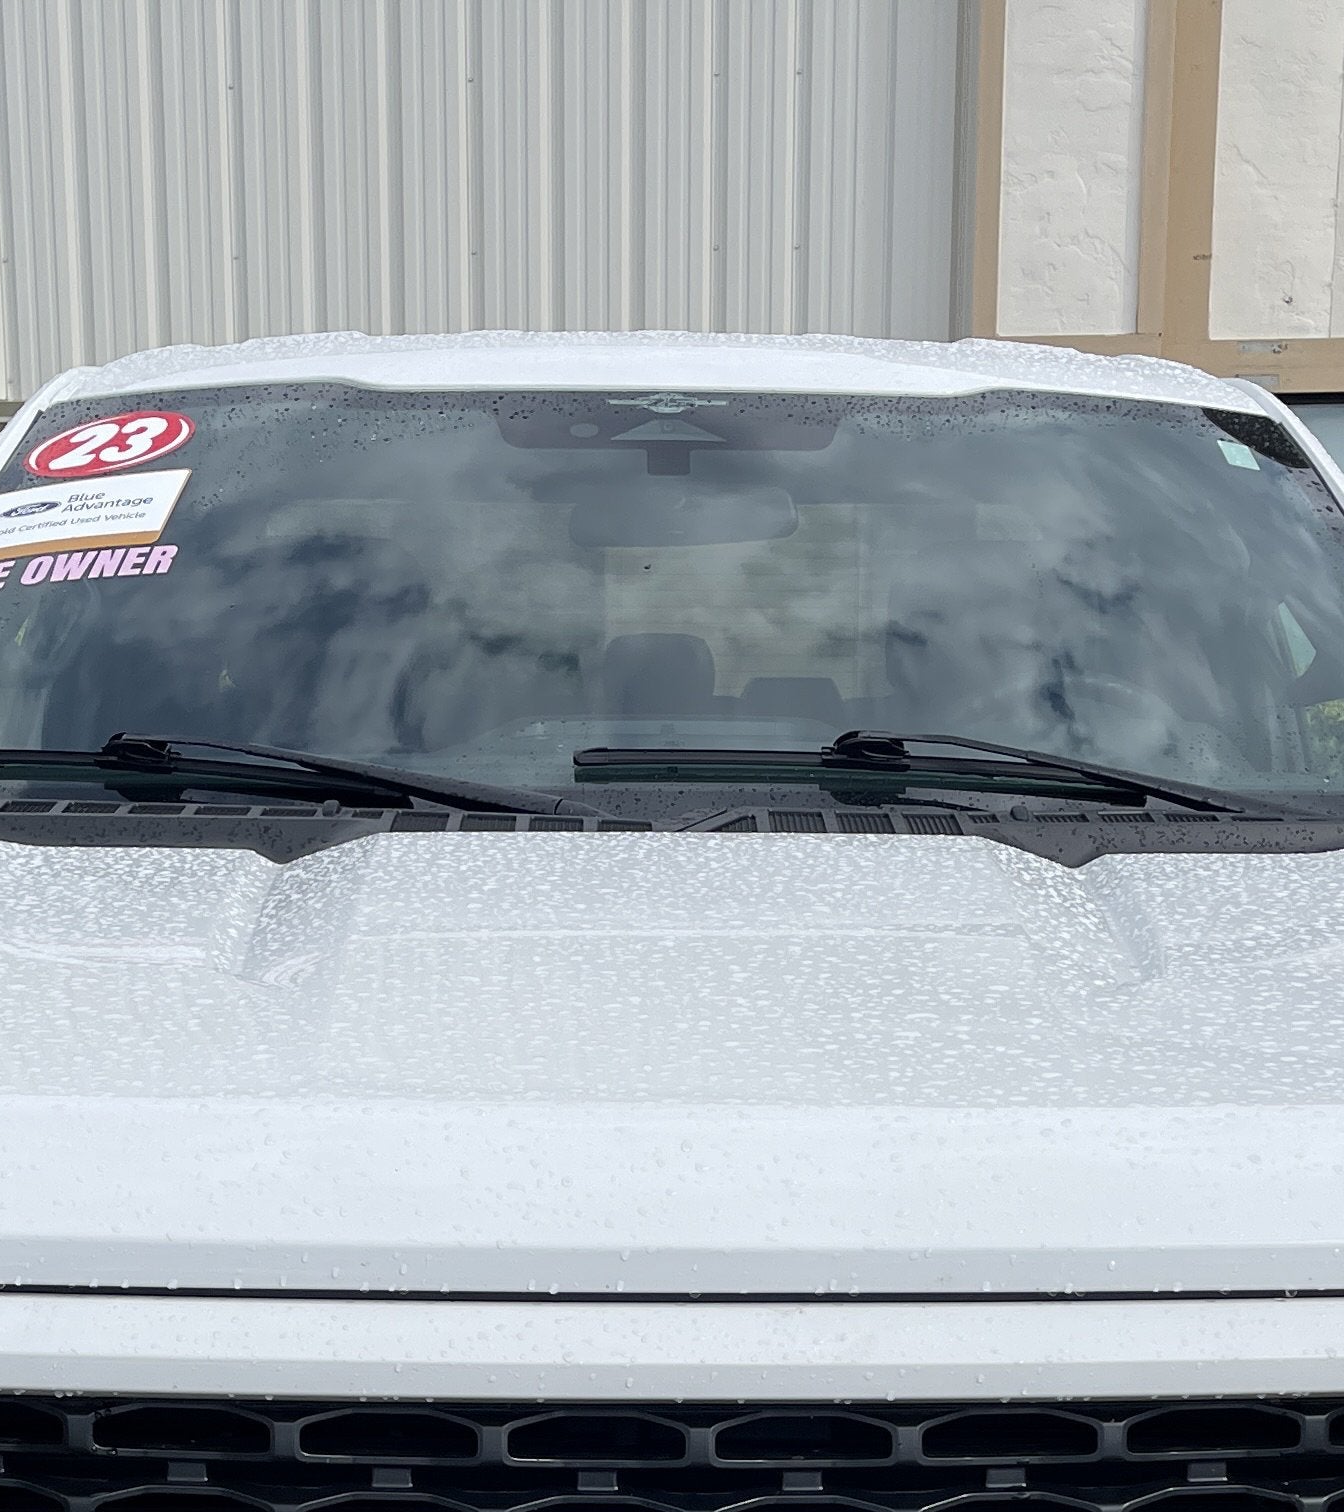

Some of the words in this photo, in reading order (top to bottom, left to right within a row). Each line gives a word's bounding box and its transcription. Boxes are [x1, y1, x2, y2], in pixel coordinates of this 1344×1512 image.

[48, 417, 169, 470] 23
[61, 497, 154, 513] Advantage
[67, 492, 105, 503] Blue
[18, 519, 67, 532] Certified
[70, 515, 100, 525] Used
[104, 511, 146, 521] Vehicle
[19, 544, 179, 586] OWNER
